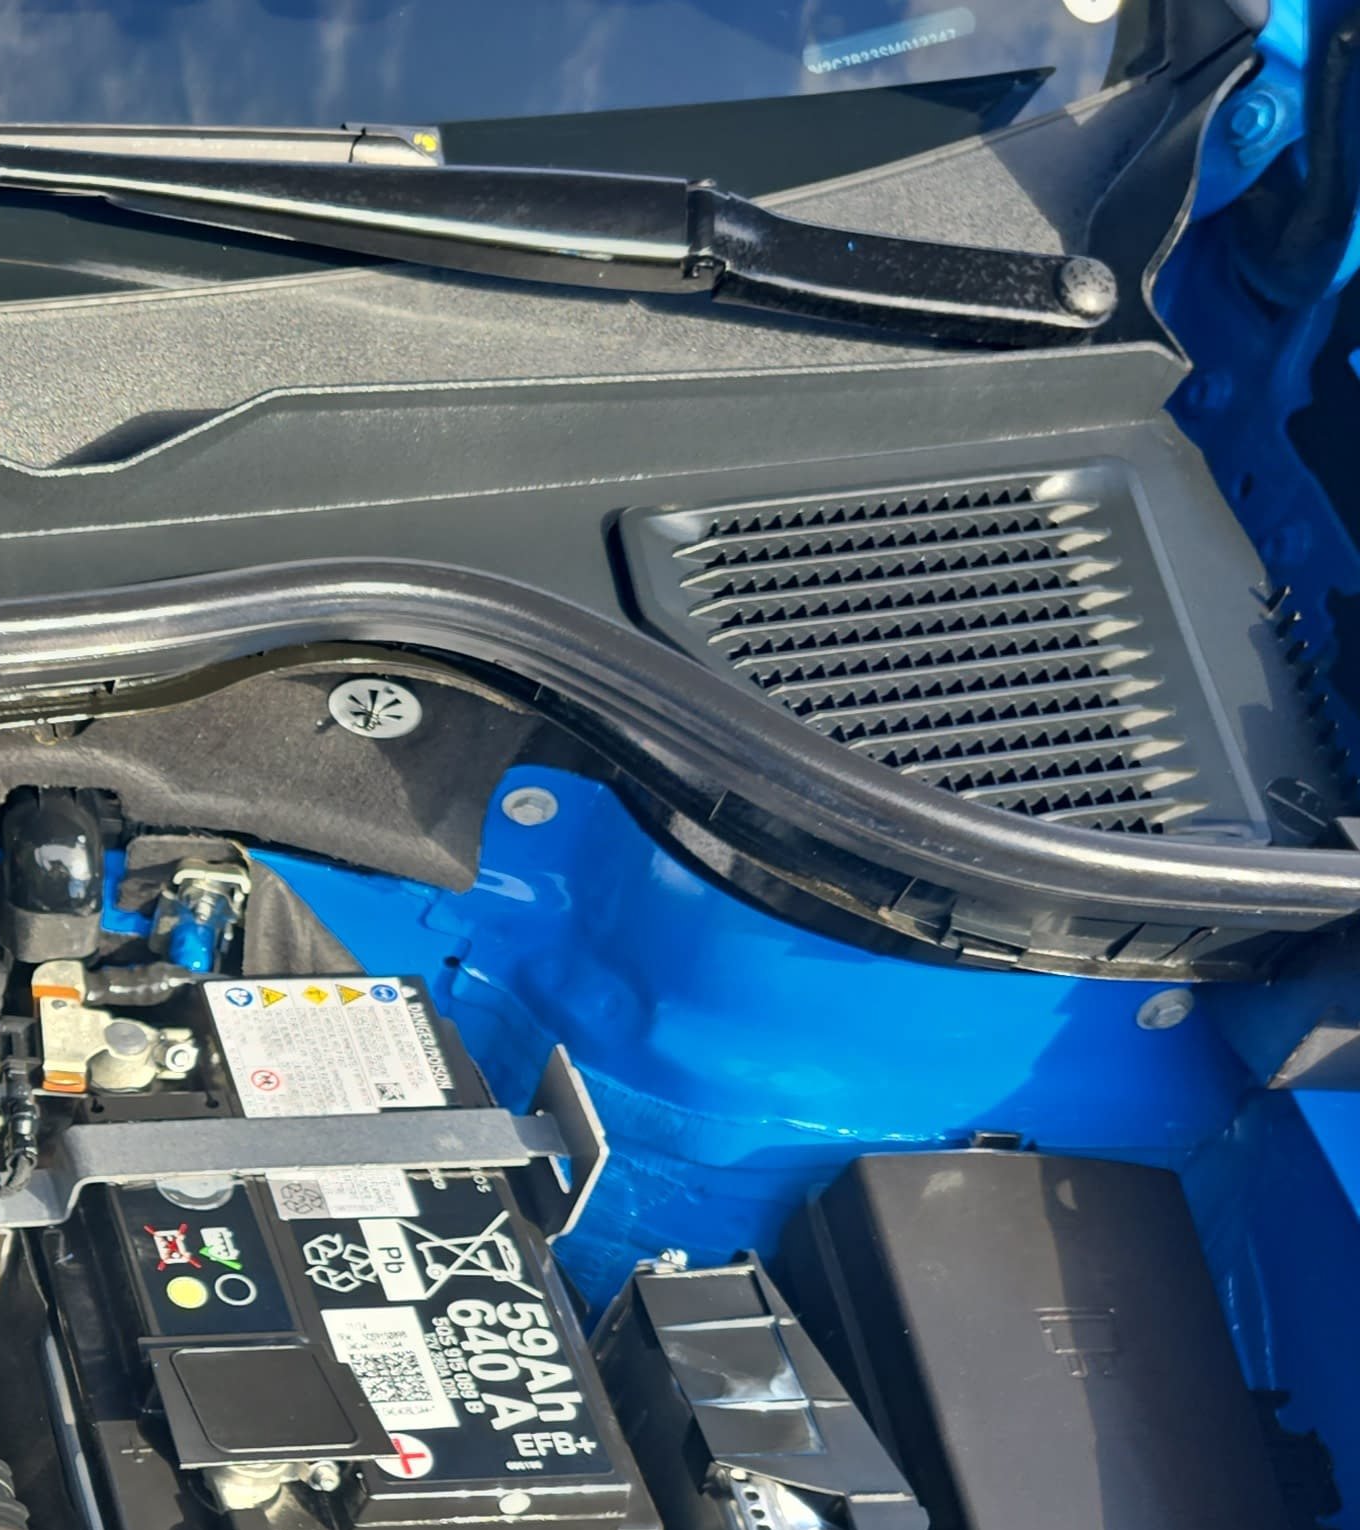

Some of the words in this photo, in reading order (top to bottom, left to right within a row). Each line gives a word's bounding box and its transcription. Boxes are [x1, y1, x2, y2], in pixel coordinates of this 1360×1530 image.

[409, 1004, 454, 1090] DANGER/POISON
[380, 1246, 403, 1275] Pb
[447, 1299, 520, 1381] 640
[445, 1348, 468, 1372] 915
[496, 1302, 582, 1422] 59Ah
[454, 1373, 479, 1398] 089
[465, 1402, 485, 1414] B
[481, 1393, 538, 1430] A
[512, 1431, 597, 1457] EFB+
